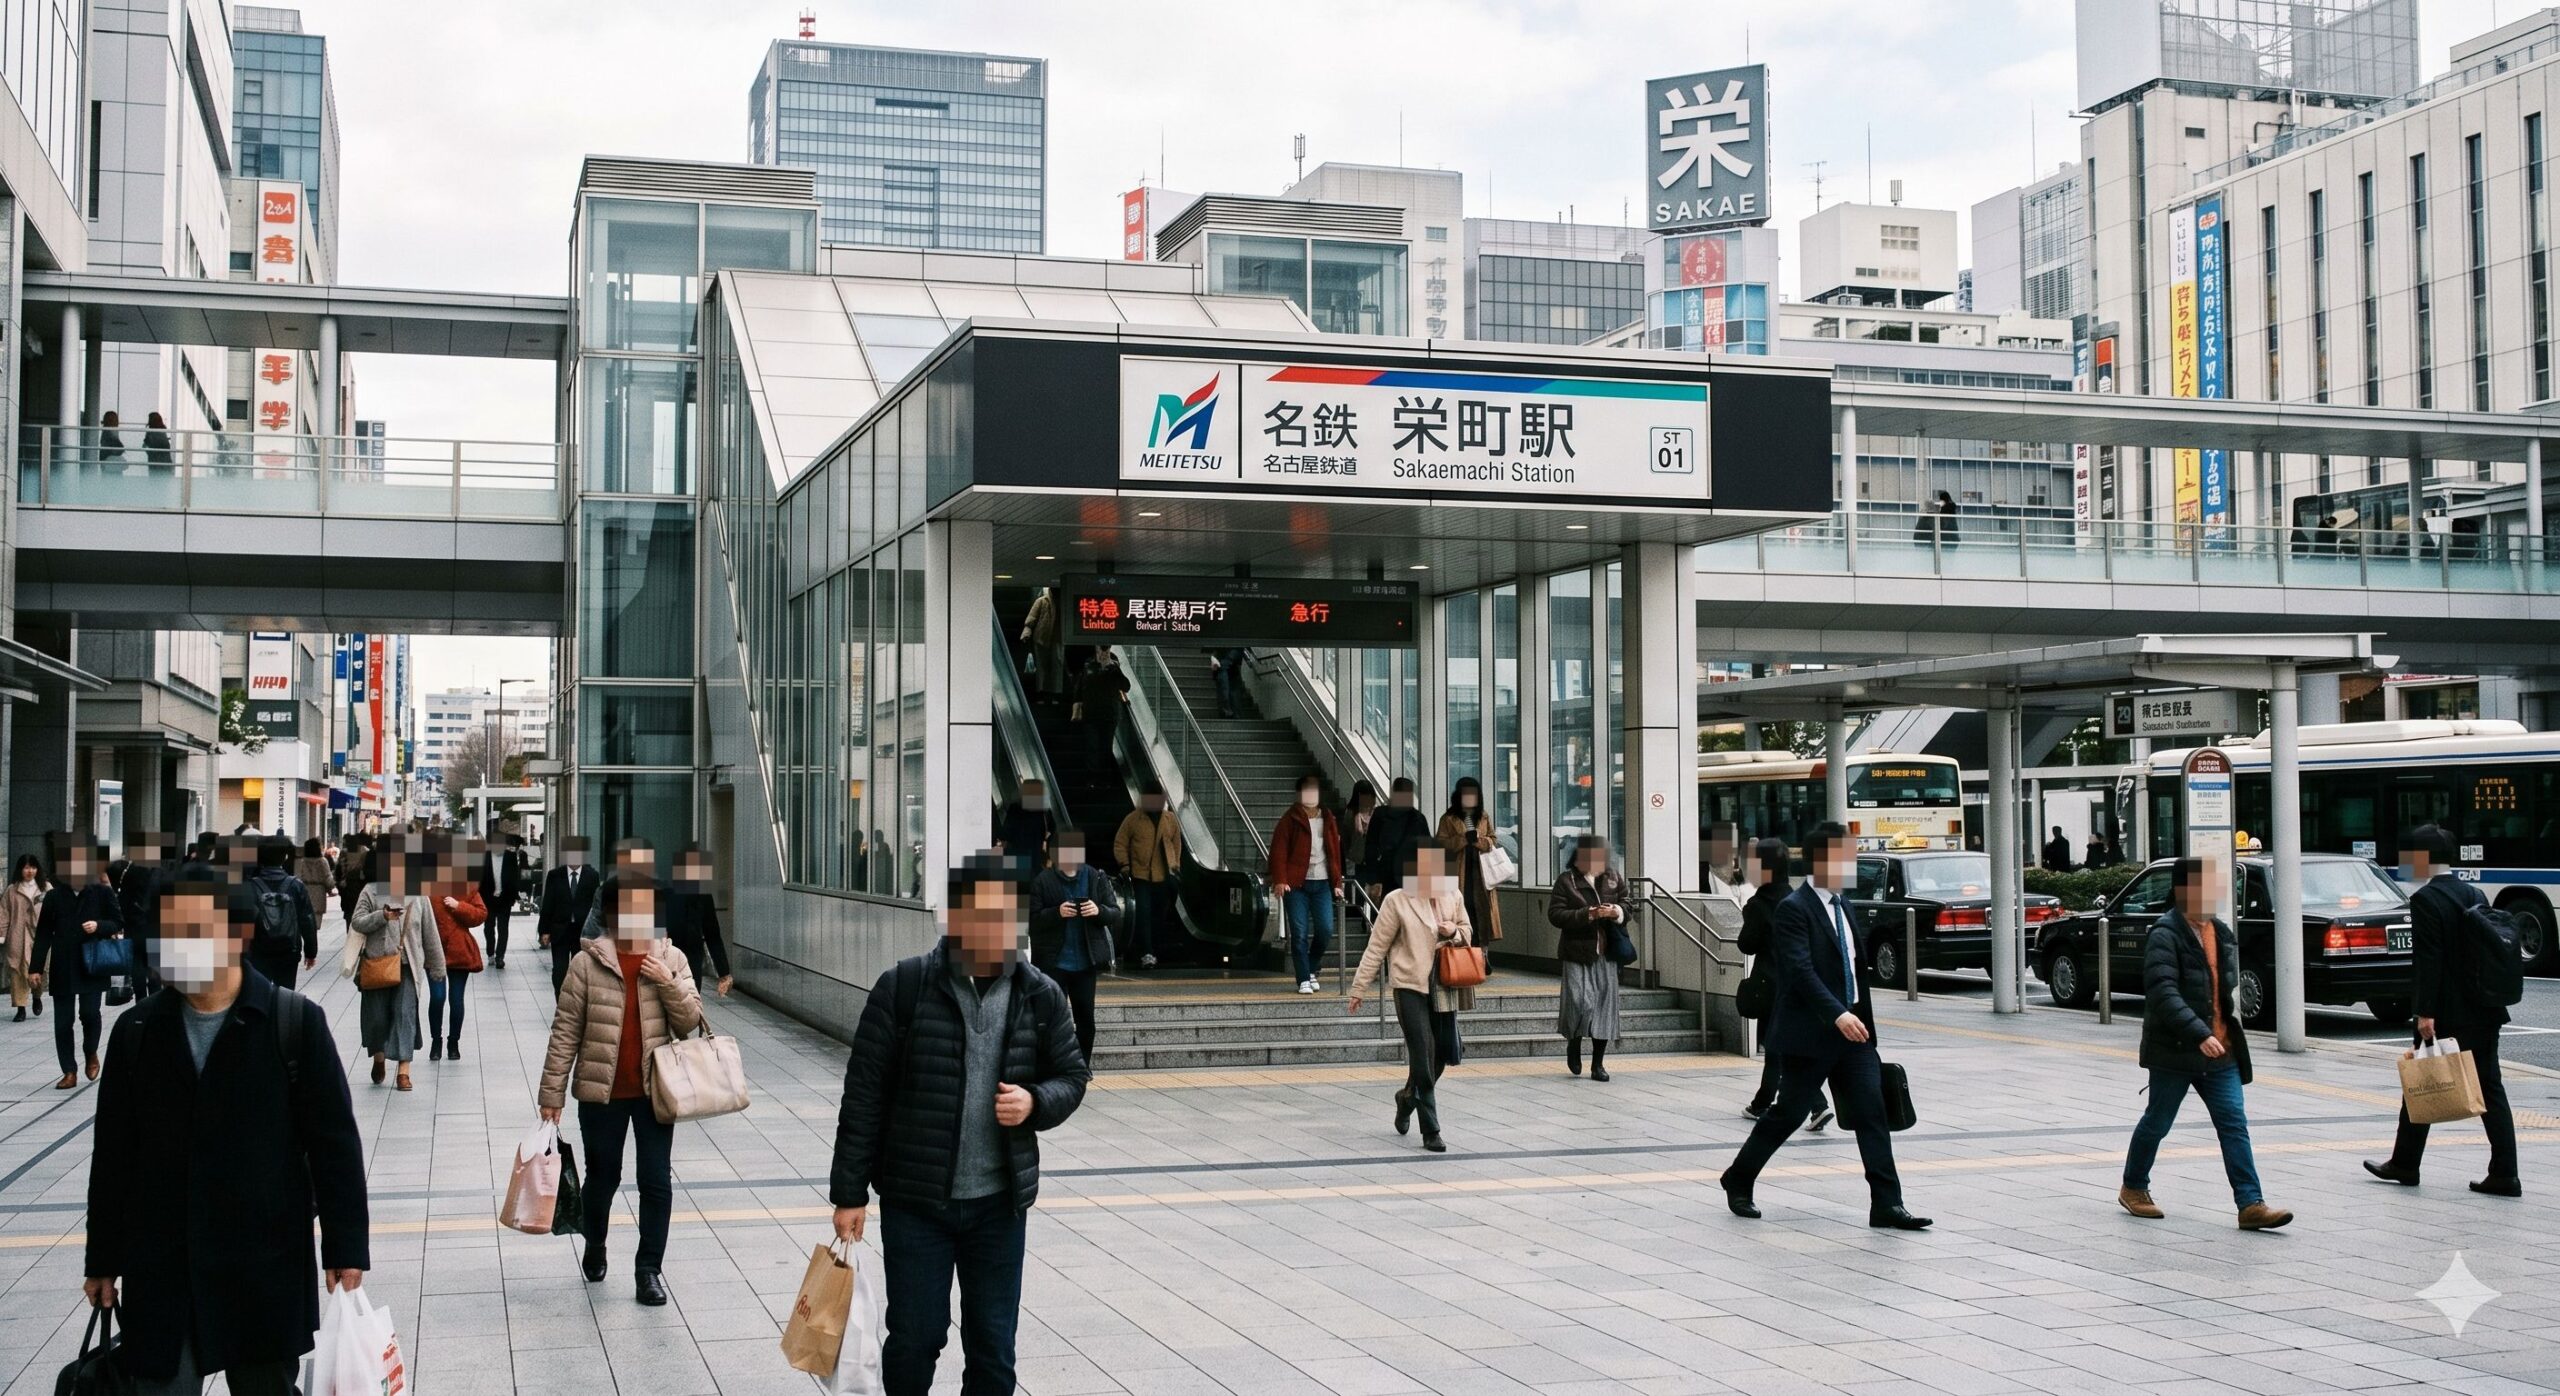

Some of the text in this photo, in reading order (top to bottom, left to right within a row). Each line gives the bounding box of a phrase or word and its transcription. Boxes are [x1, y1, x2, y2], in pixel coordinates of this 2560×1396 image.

[1656, 79, 1754, 190] 栄
[1655, 193, 1756, 224] SAKAE
[1263, 396, 1576, 459] 名鉄 栄町駅
[1663, 431, 1681, 445] ST
[1139, 453, 1222, 470] MEITETSU
[1263, 454, 1358, 476] 名古屋鉄道
[1658, 447, 1684, 468] 01
[1393, 457, 1575, 484] Sakaemachi Station
[1079, 598, 1329, 623] 特急 尾張瀬戸行 急行
